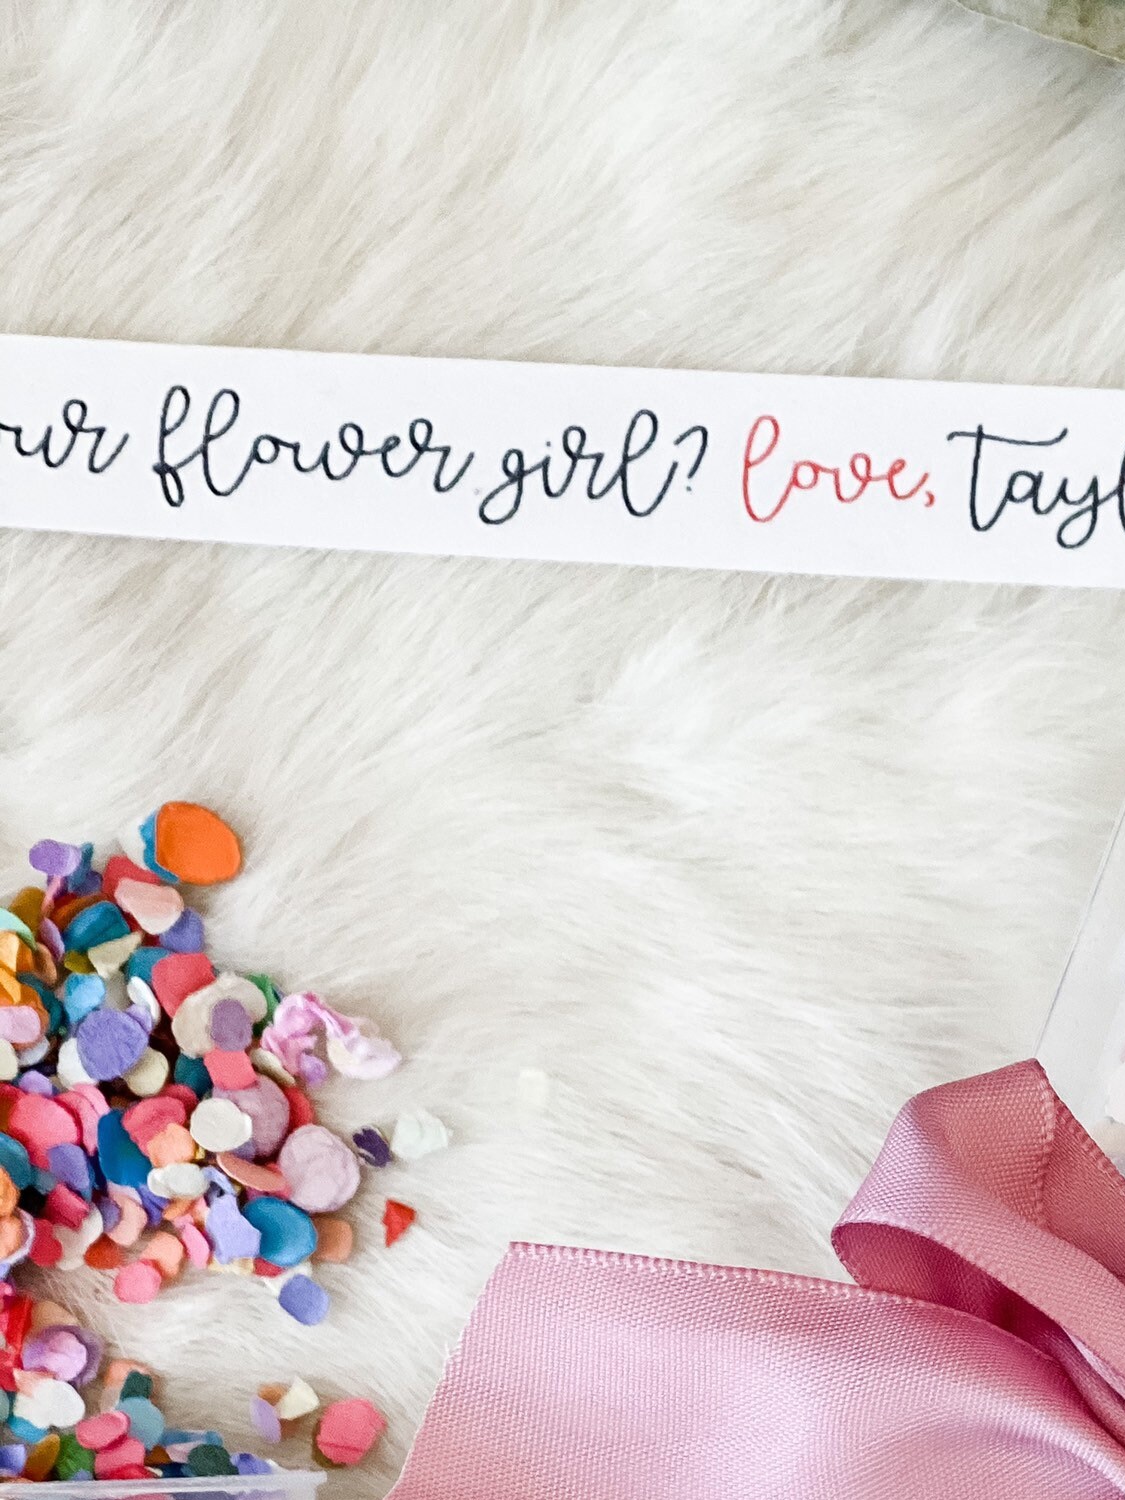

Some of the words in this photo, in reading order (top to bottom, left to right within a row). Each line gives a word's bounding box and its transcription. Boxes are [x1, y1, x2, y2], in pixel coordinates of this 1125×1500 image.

[0, 398, 130, 474] ur
[151, 385, 475, 508] flower
[478, 408, 709, 526] girl?
[742, 414, 936, 523] love,
